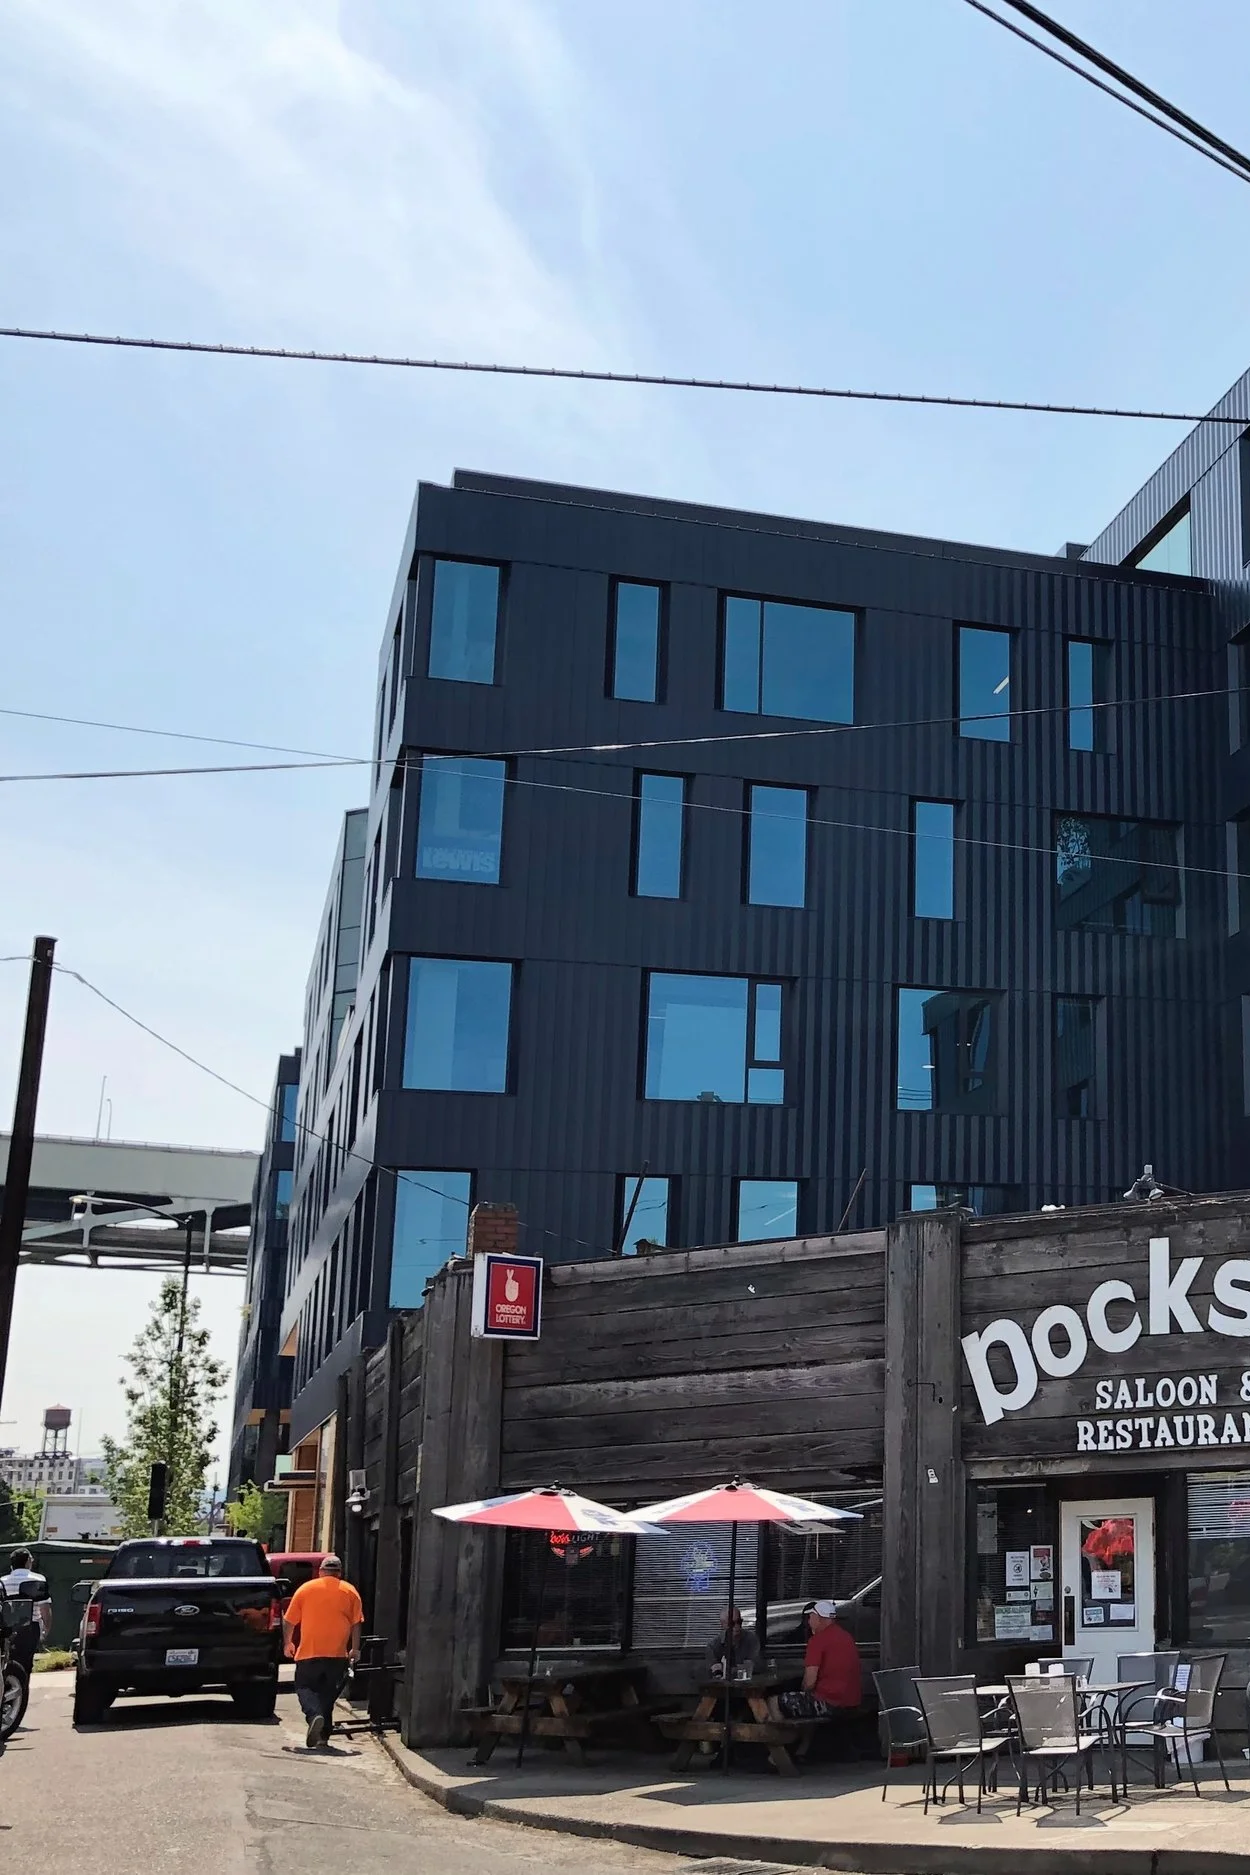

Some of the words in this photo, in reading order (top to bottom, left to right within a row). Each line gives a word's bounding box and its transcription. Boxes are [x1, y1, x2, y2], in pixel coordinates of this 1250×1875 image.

[495, 1304, 527, 1315] OREGON
[1095, 1374, 1218, 1410] SALOON
[572, 1532, 601, 1543] LIGHT
